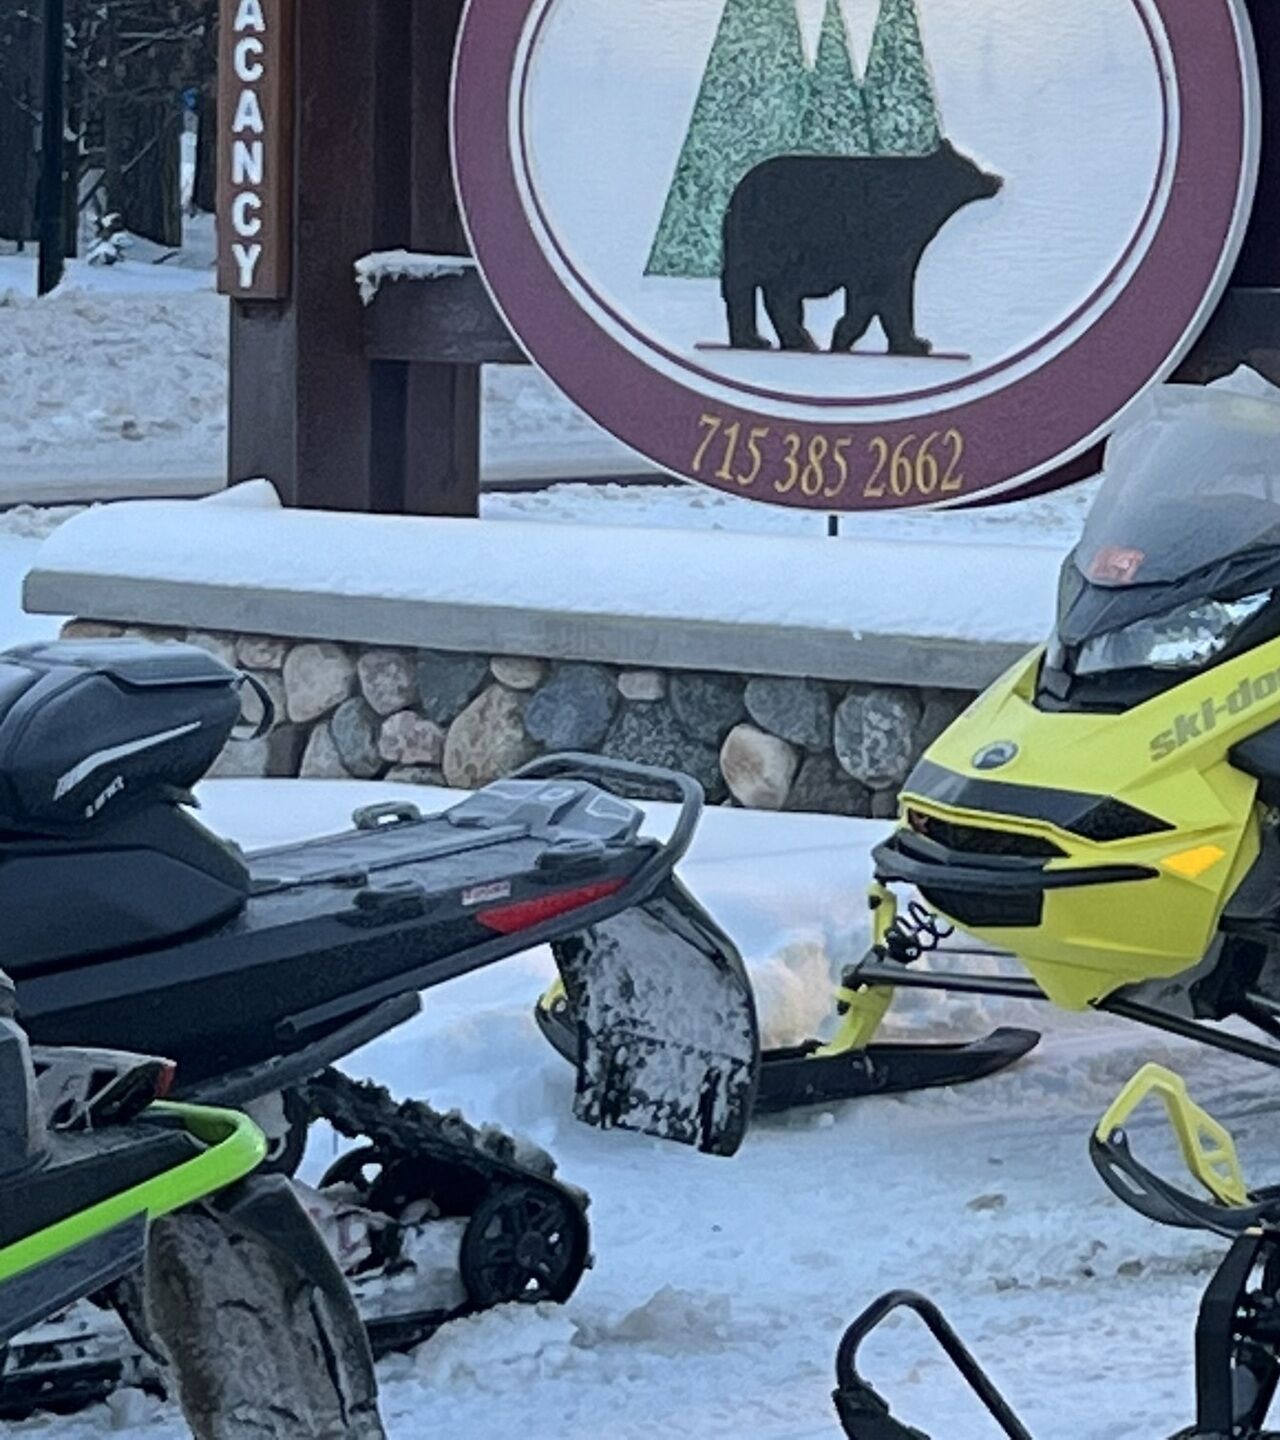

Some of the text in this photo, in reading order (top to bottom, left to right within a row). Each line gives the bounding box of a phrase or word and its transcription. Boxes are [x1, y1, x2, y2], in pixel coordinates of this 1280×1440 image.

[692, 413, 964, 498] 715 385 2662
